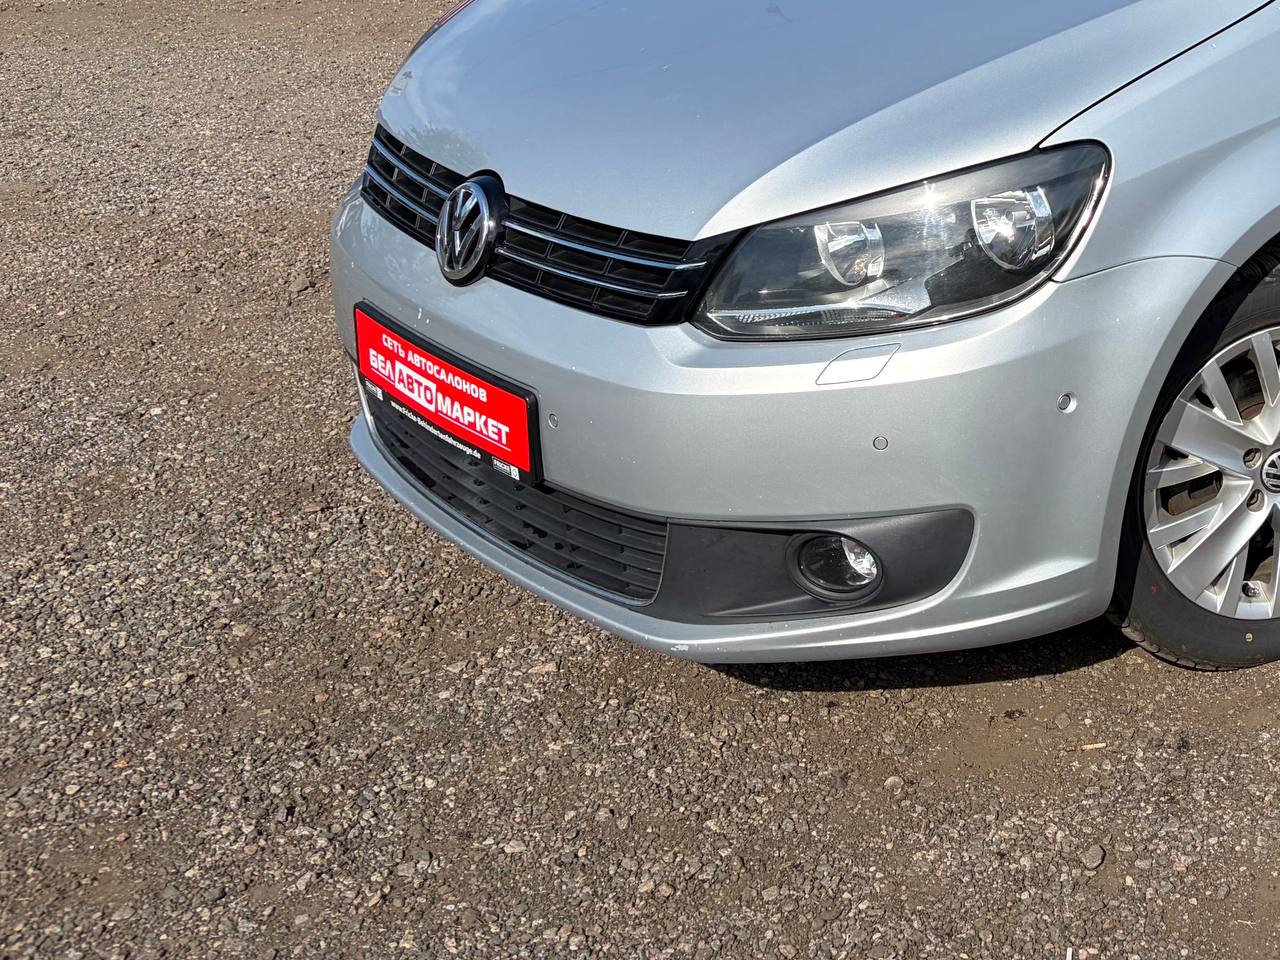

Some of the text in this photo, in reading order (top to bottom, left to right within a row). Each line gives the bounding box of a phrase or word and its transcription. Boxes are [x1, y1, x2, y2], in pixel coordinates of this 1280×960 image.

[369, 348, 395, 381] БЕЛ
[397, 367, 434, 408] АВТО
[436, 392, 510, 446] МАРКЕТ
[382, 333, 405, 358] СЕТЬ
[407, 349, 488, 403] АВТОСАЛОНОВ
